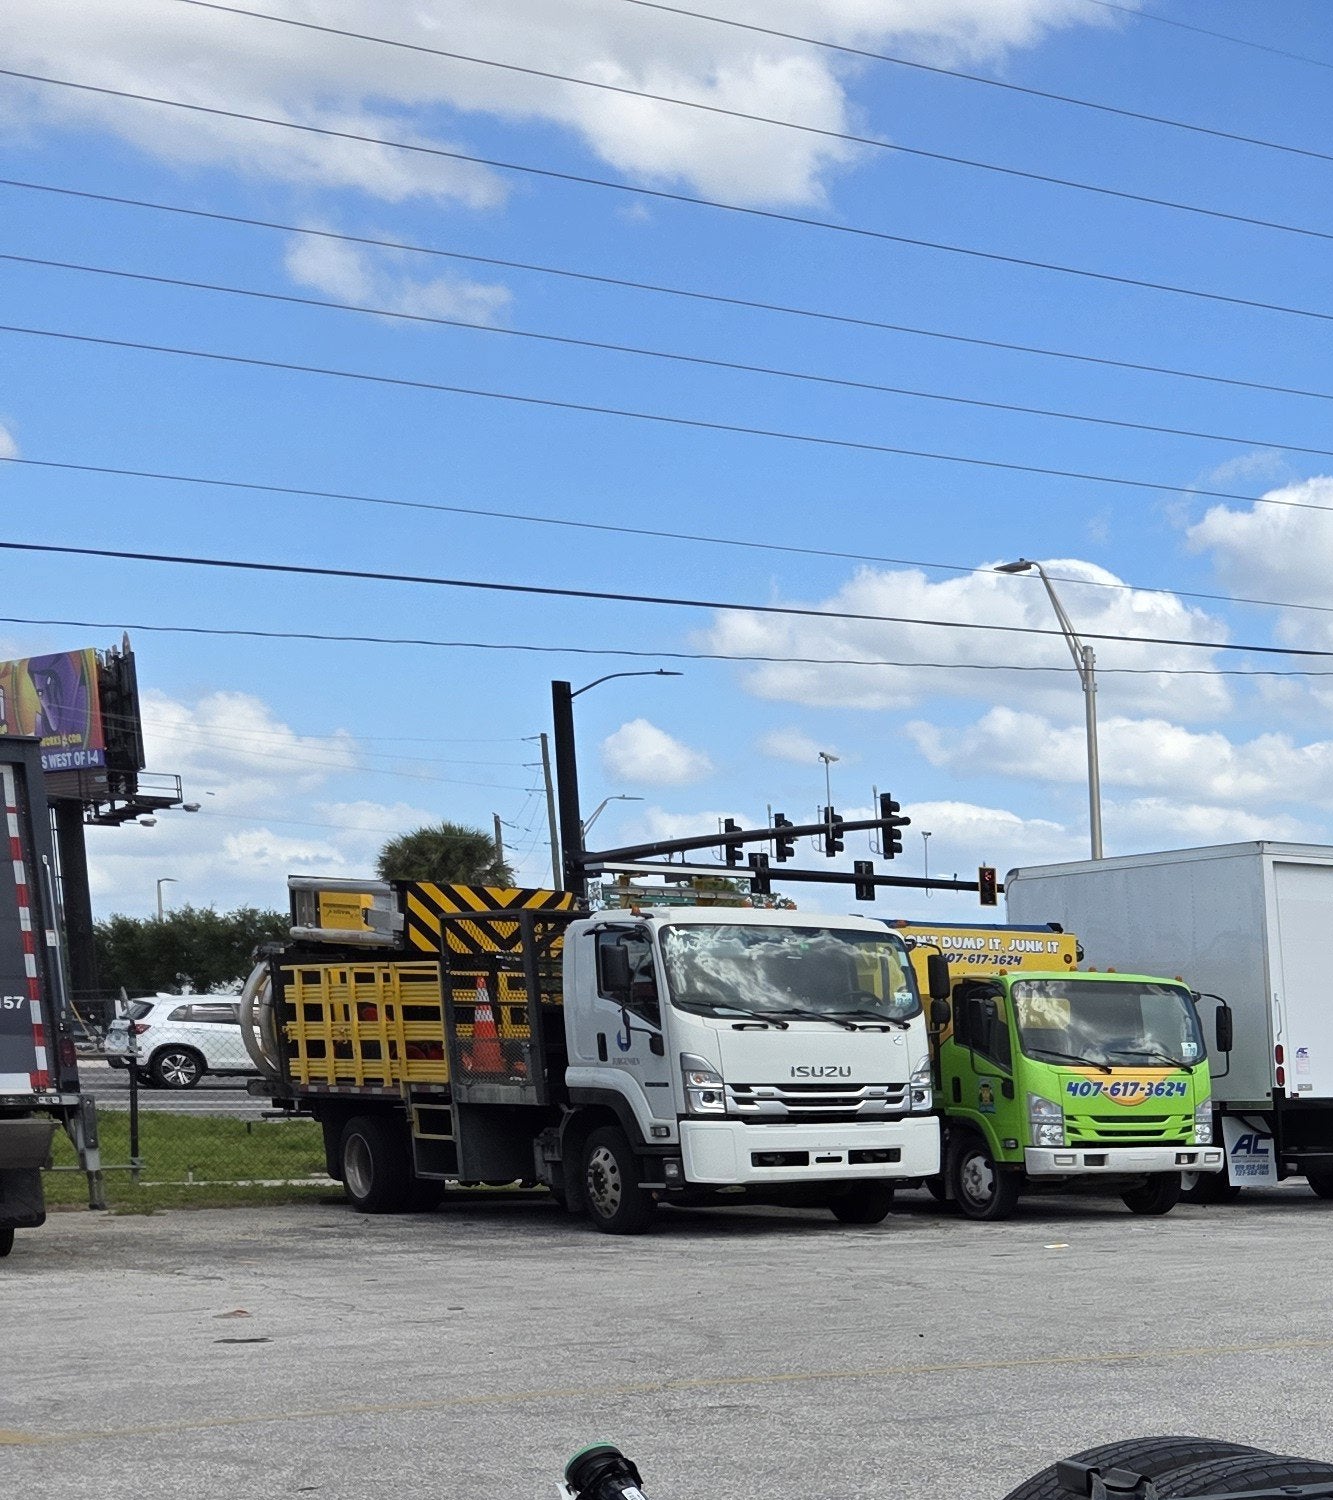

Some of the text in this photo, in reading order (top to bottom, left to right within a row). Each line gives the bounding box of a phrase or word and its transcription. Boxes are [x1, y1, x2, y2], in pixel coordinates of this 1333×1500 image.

[49, 753, 71, 768] WEST
[74, 752, 85, 766] OF
[88, 750, 99, 764] I-4
[942, 936, 985, 950] DUMP
[1008, 940, 1044, 953] JUNK
[1047, 941, 1060, 953] IT
[790, 1065, 852, 1078] ISUZU
[1066, 1081, 1187, 1097] 407-617-3624
[1230, 1134, 1273, 1155] AC
